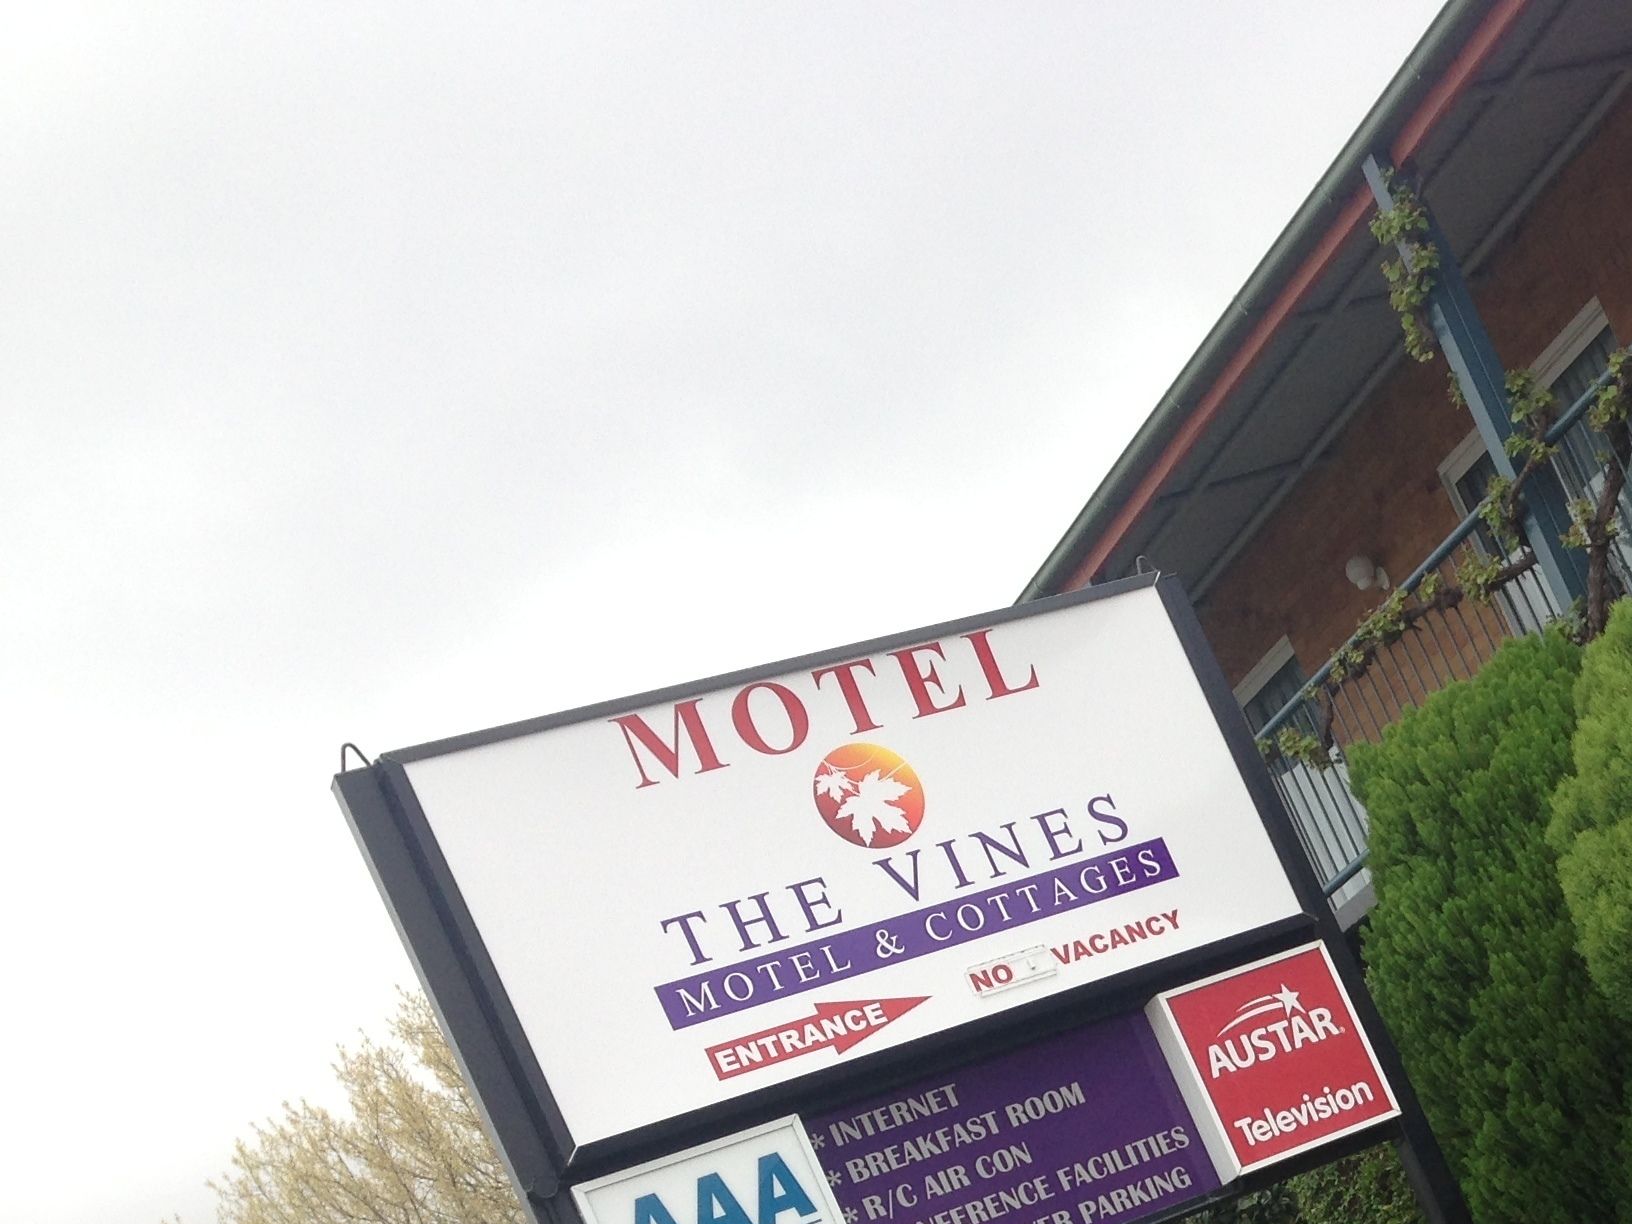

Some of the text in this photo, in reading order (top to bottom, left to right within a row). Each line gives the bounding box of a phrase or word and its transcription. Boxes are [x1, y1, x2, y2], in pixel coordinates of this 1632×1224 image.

[608, 628, 1040, 789] MOTEL
[661, 793, 1129, 966] THE VINES
[675, 848, 1164, 1018] MOTEL & COTTAGES
[969, 909, 1181, 992] NO VACANCY
[715, 1002, 889, 1075] ENTRANCE
[1207, 1007, 1341, 1079] AUSTAR
[829, 1083, 959, 1147] INTERNET
[845, 1081, 1086, 1184] BREAKFAST ROOM
[1234, 1081, 1374, 1146] Television
[862, 1141, 1032, 1221] R/C AIR CON
[1056, 1125, 1190, 1191] FACILITIES
